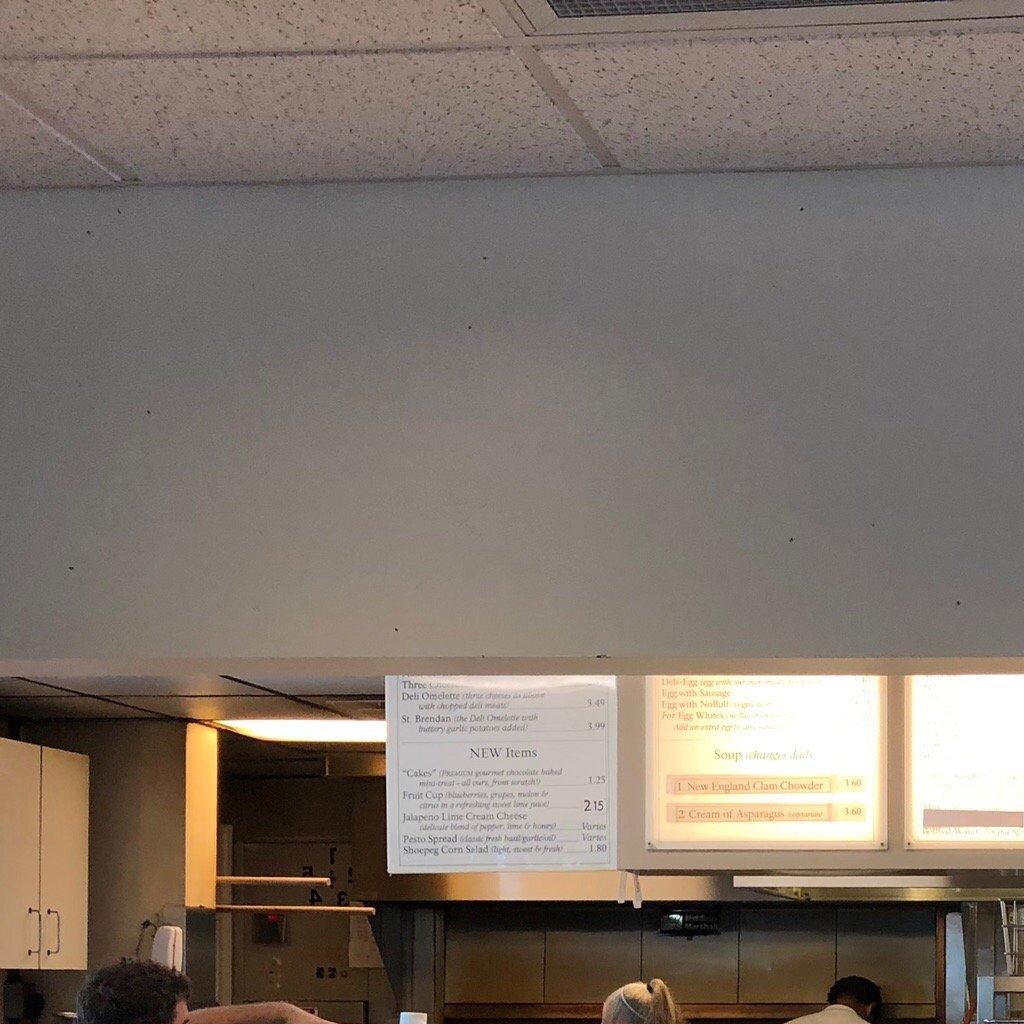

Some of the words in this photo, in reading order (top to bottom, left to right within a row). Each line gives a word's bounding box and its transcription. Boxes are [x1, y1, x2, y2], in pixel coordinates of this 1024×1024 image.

[401, 681, 427, 689] Three
[401, 692, 419, 701] Deli
[421, 692, 460, 700] Omelette
[662, 690, 678, 699] Egg
[679, 689, 697, 697] with
[699, 689, 731, 698] Sausage
[662, 701, 678, 710] Egg
[679, 701, 698, 709] with
[415, 715, 451, 723] Brendan
[469, 714, 485, 722] Deli
[678, 712, 694, 722] Egg
[469, 748, 502, 759] NEW
[505, 747, 538, 758] Items
[714, 749, 743, 763] Soup
[588, 776, 606, 784] 1.25
[844, 779, 862, 788] 3.60
[687, 782, 709, 791] New
[712, 781, 751, 793] England
[752, 781, 778, 791] Clam
[779, 781, 824, 791] Chowder
[402, 791, 423, 800] Fruit
[425, 791, 444, 801] Cup
[688, 809, 720, 819] Cream
[722, 809, 733, 819] of
[736, 809, 785, 822] Asparagus
[844, 807, 862, 816] 3.60
[402, 813, 440, 824] Jalapeno
[441, 813, 463, 821] Lime
[465, 812, 495, 820] Cream
[496, 812, 528, 820] Cheese
[582, 822, 607, 831] Varies
[403, 835, 427, 843] Pesto
[428, 835, 458, 845] Spread
[582, 834, 607, 842] Varies
[403, 846, 440, 856] Shoepeg
[441, 846, 464, 854] Corn
[465, 845, 489, 854] Salad
[589, 844, 607, 853] 1.80
